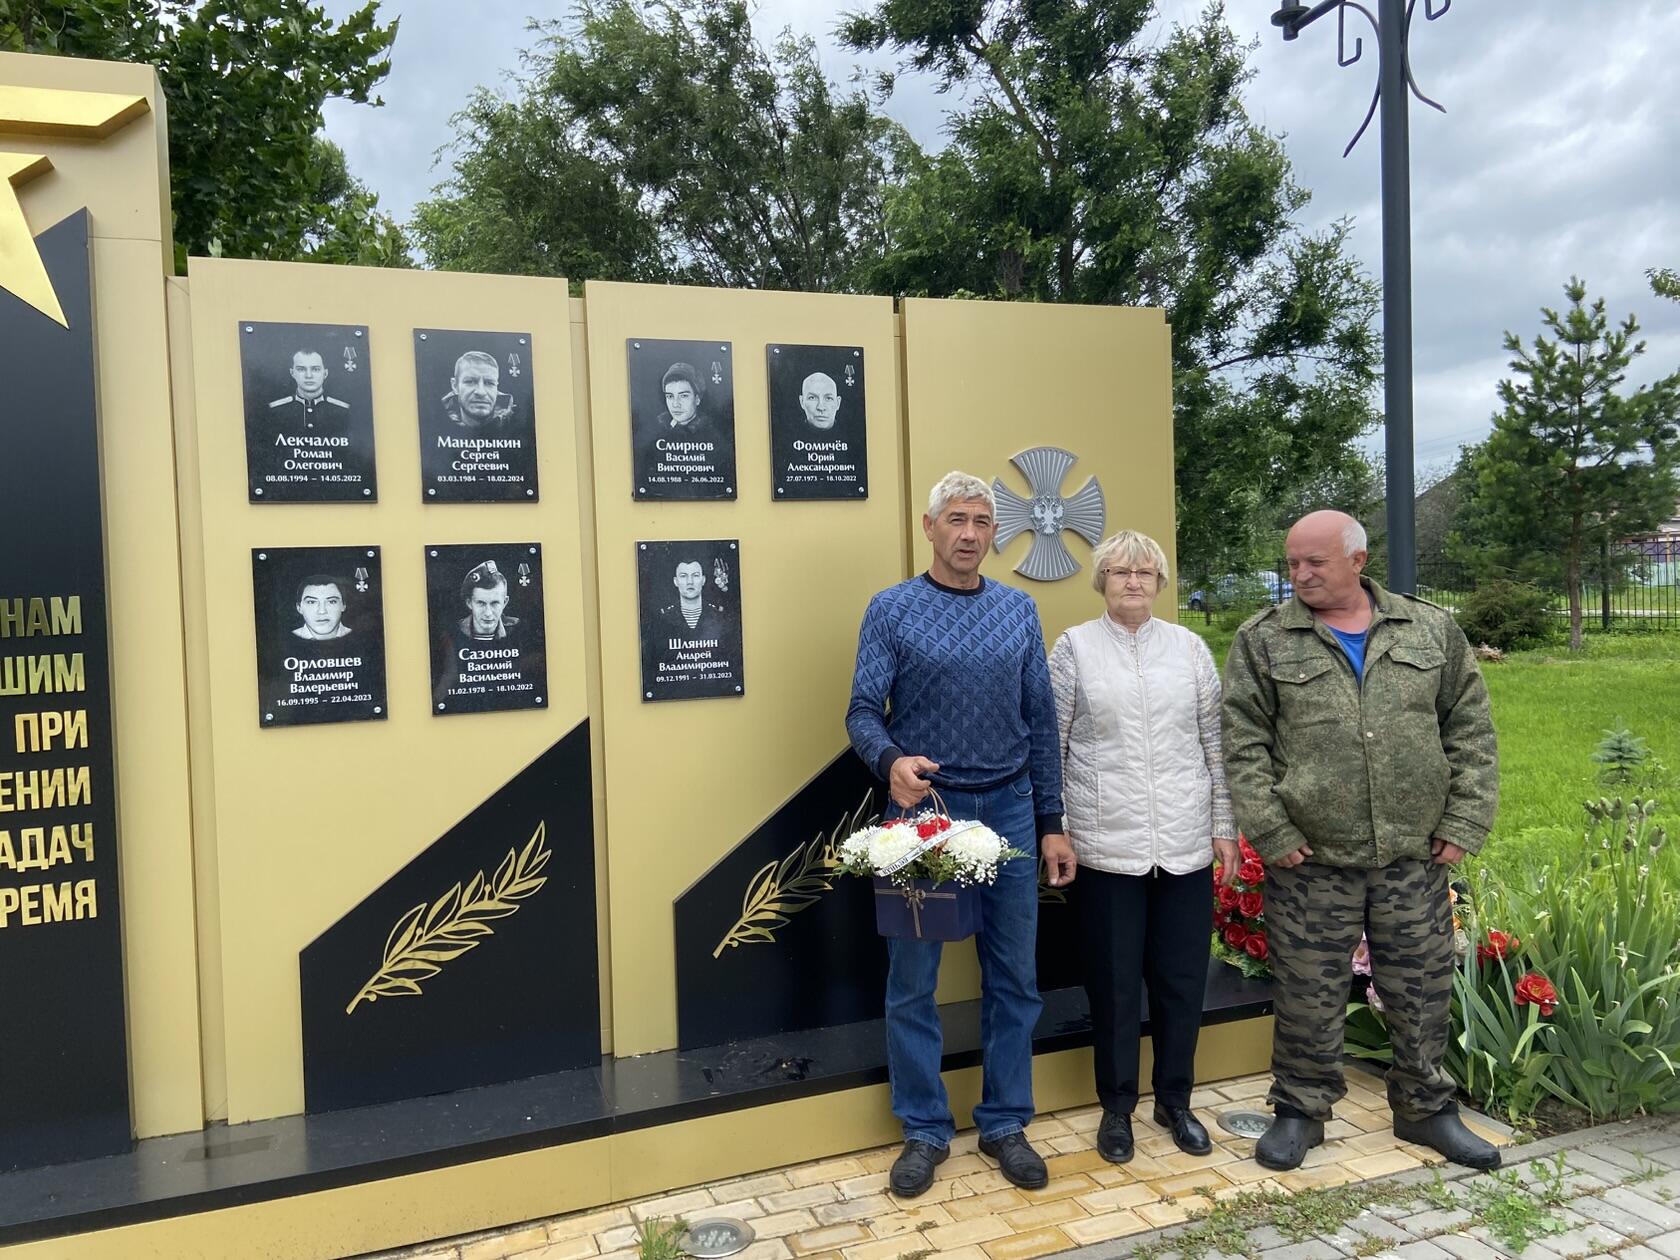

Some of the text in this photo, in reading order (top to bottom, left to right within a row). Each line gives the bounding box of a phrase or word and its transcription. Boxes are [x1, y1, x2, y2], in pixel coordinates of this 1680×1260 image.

[275, 433, 349, 447] Лекчалов
[437, 436, 521, 451] Мандрыкин
[655, 438, 714, 454] Смирнов
[793, 439, 848, 452] Фомичёв
[293, 448, 332, 459] Роман
[461, 449, 499, 462] Сергей
[666, 452, 705, 462] Василий
[807, 452, 835, 463] Юрий
[284, 459, 343, 471] Олегович
[452, 460, 509, 473] Сергеевич
[657, 463, 715, 474] Викторович
[787, 462, 855, 473] Александрович
[487, 475, 524, 483] 18.02.2024
[668, 638, 718, 650] Шлянин
[458, 647, 519, 661] Сазонов
[676, 650, 712, 661] Андрей
[283, 656, 362, 673] Орловцев
[467, 660, 513, 672] Василий
[659, 660, 729, 672] Владимирович
[294, 669, 353, 684] Владимир
[459, 671, 521, 683] Васильевич
[290, 682, 359, 695] Валерьевич
[448, 686, 485, 695] 11.02.1978
[496, 683, 533, 692] 18.10.2022
[276, 697, 319, 706] 16.09.1995
[331, 694, 372, 703] 22.04.2023
[14, 709, 89, 753] ПРИ
[0, 766, 92, 813] ЕНИИ
[0, 878, 98, 928] РЕМЯ
